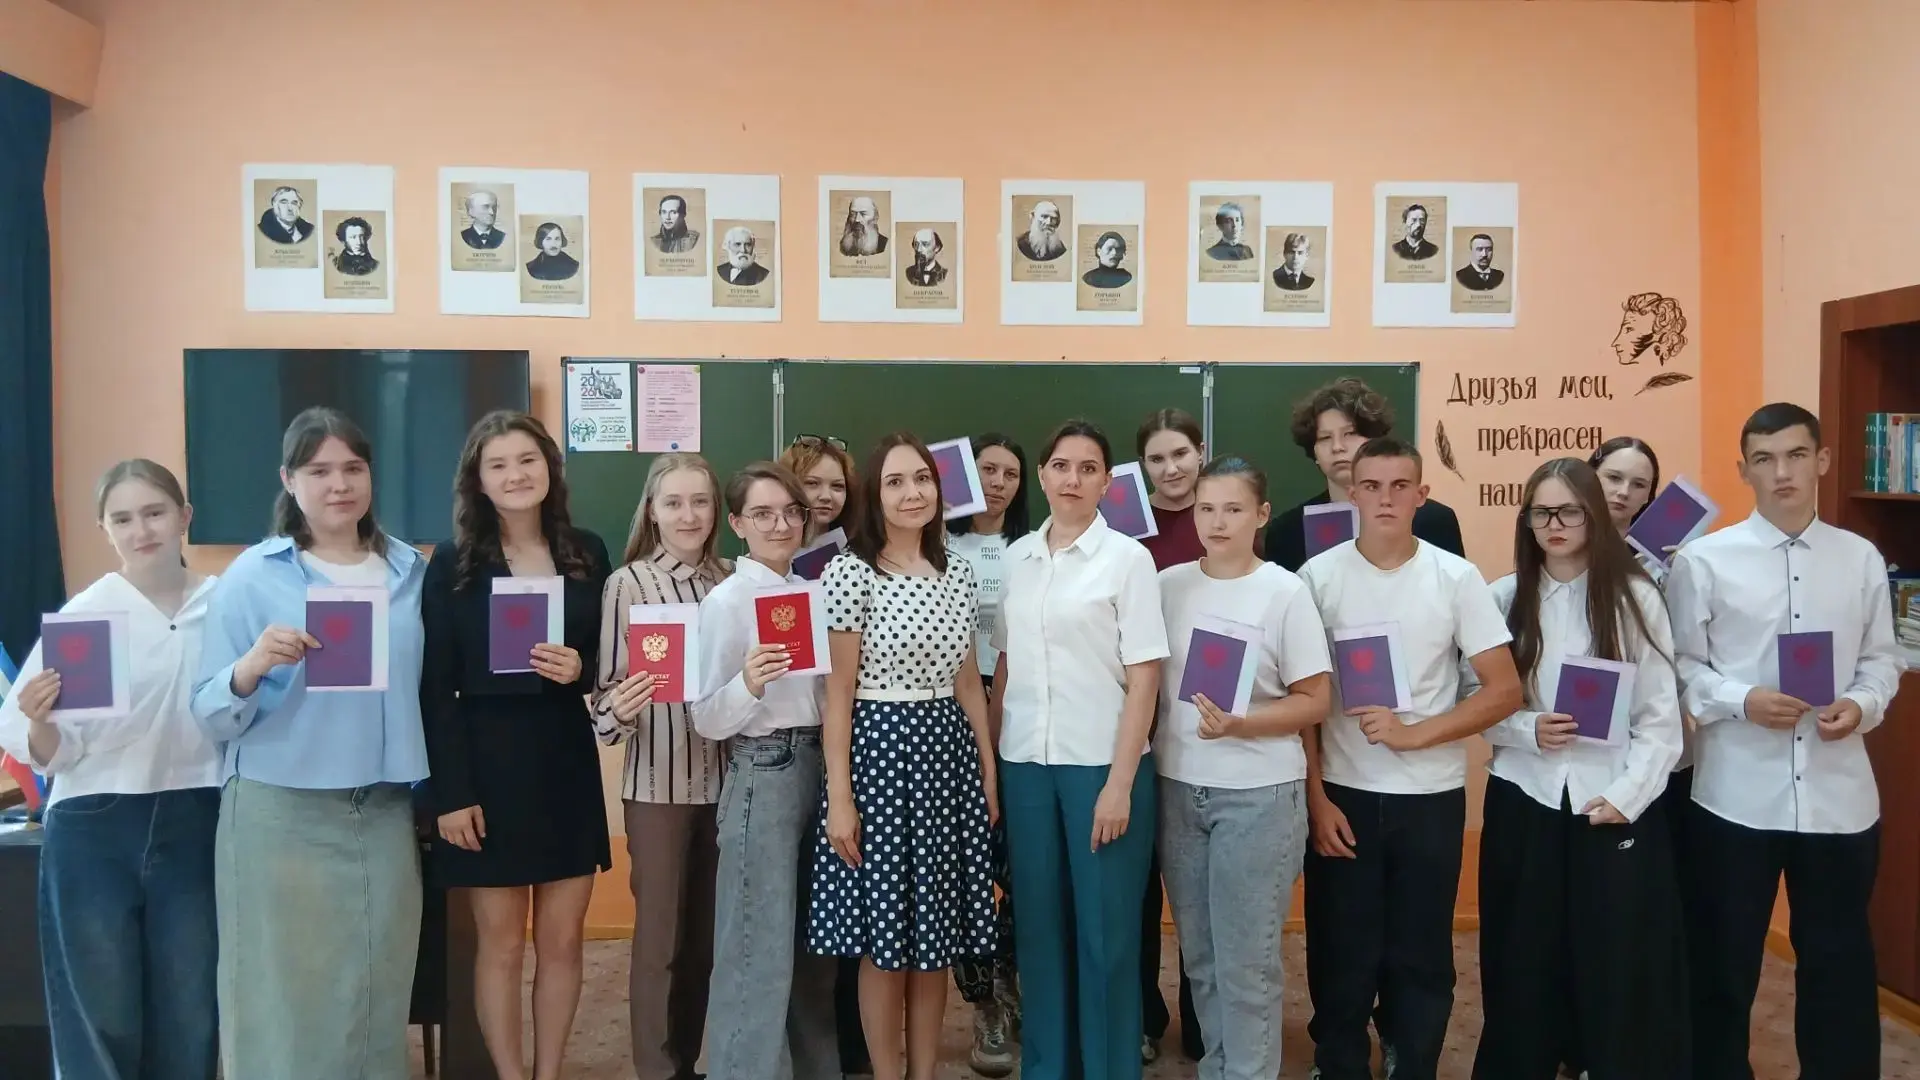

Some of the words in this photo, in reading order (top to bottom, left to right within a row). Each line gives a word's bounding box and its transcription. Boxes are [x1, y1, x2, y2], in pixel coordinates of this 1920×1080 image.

[1447, 372, 1537, 406] Друзья
[1558, 375, 1613, 400] мои,
[1478, 425, 1603, 456] прекрасен
